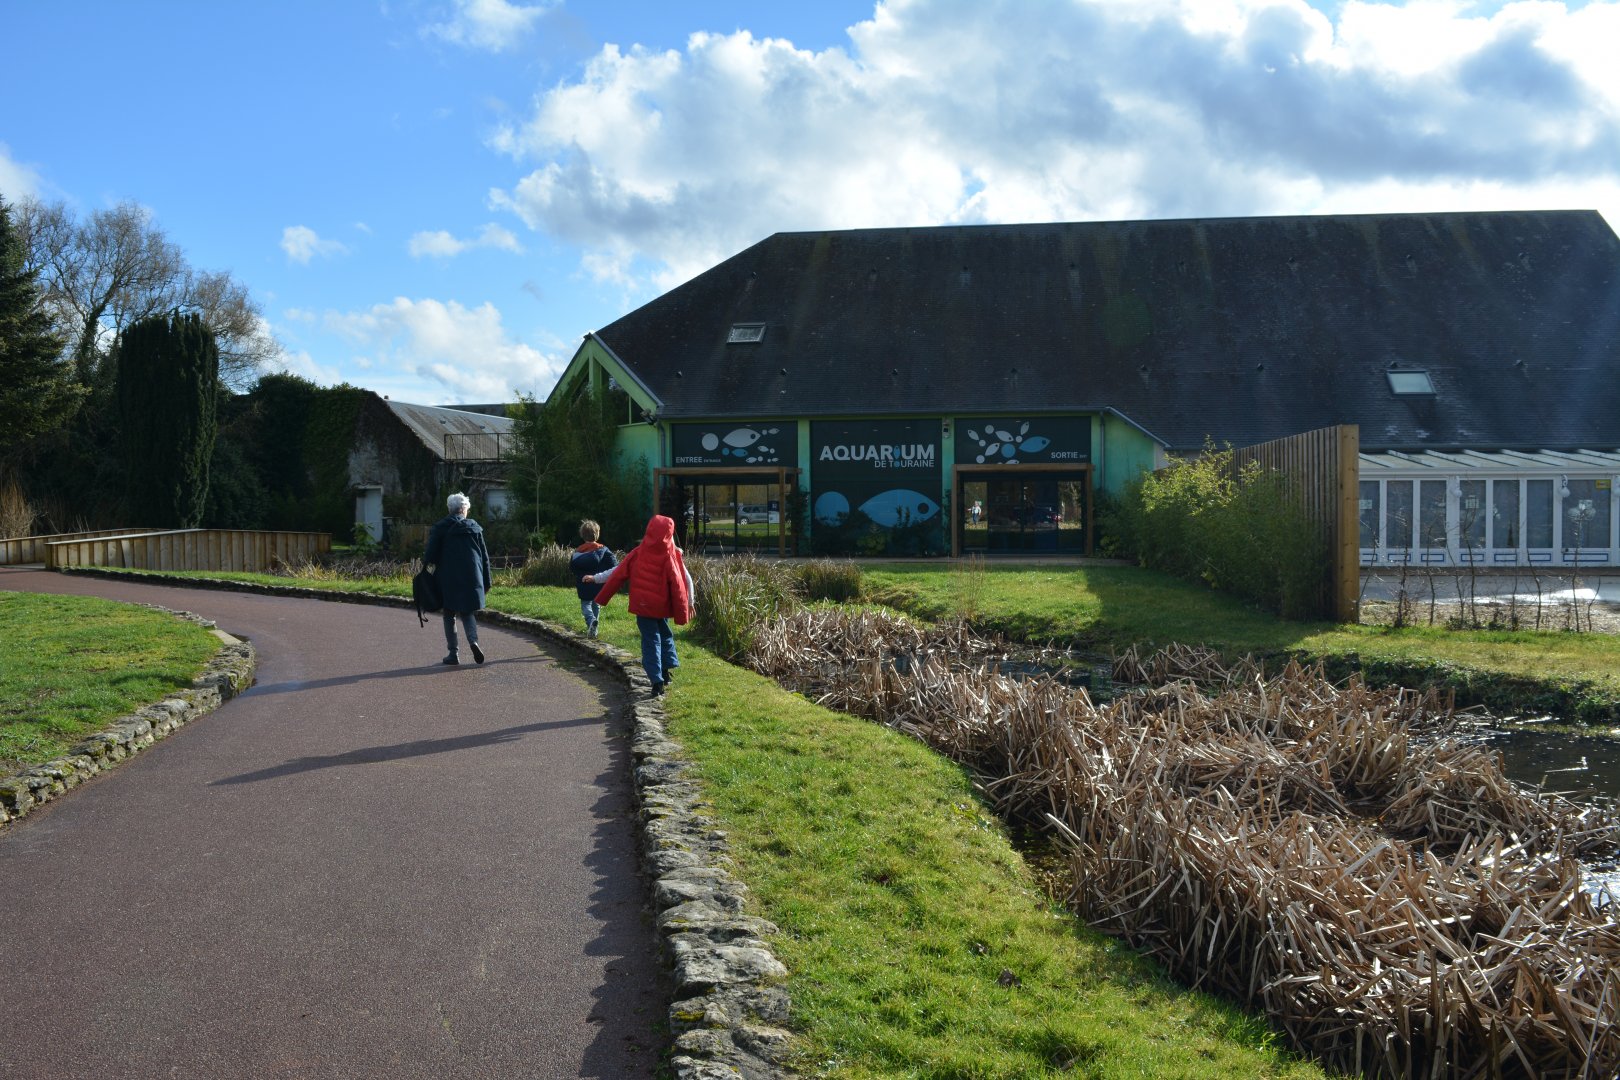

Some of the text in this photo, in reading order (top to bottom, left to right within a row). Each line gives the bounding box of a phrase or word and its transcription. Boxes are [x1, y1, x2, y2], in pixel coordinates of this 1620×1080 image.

[819, 444, 935, 461] AQUARIUM
[1050, 451, 1079, 459] SORTIE
[874, 460, 935, 468] DE TOURAINE
